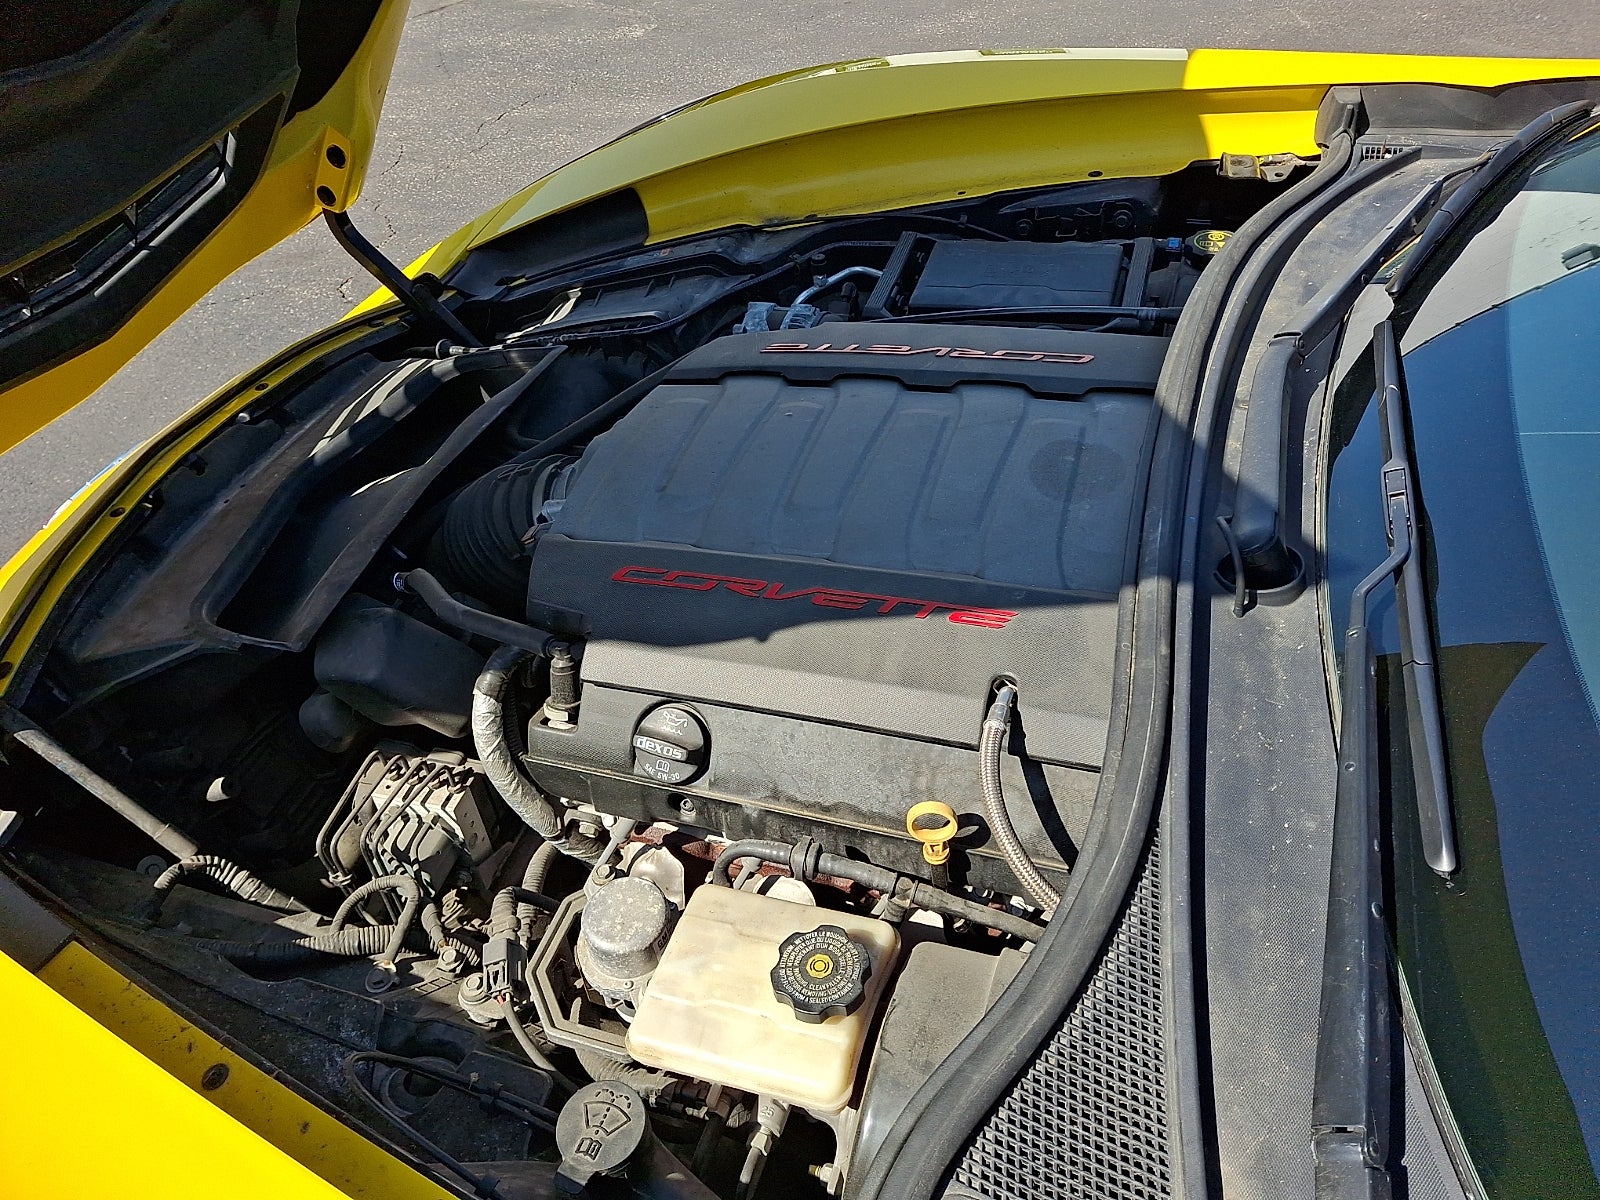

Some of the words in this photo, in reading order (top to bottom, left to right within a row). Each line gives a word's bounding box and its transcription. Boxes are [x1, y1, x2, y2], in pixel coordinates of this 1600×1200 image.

[759, 343, 1095, 364] CORVETTE
[611, 565, 1019, 629] CORVETTE
[636, 737, 683, 760] dexos
[644, 763, 657, 776] SAE
[657, 772, 680, 781] 5W-30
[809, 983, 827, 991] CLEAN
